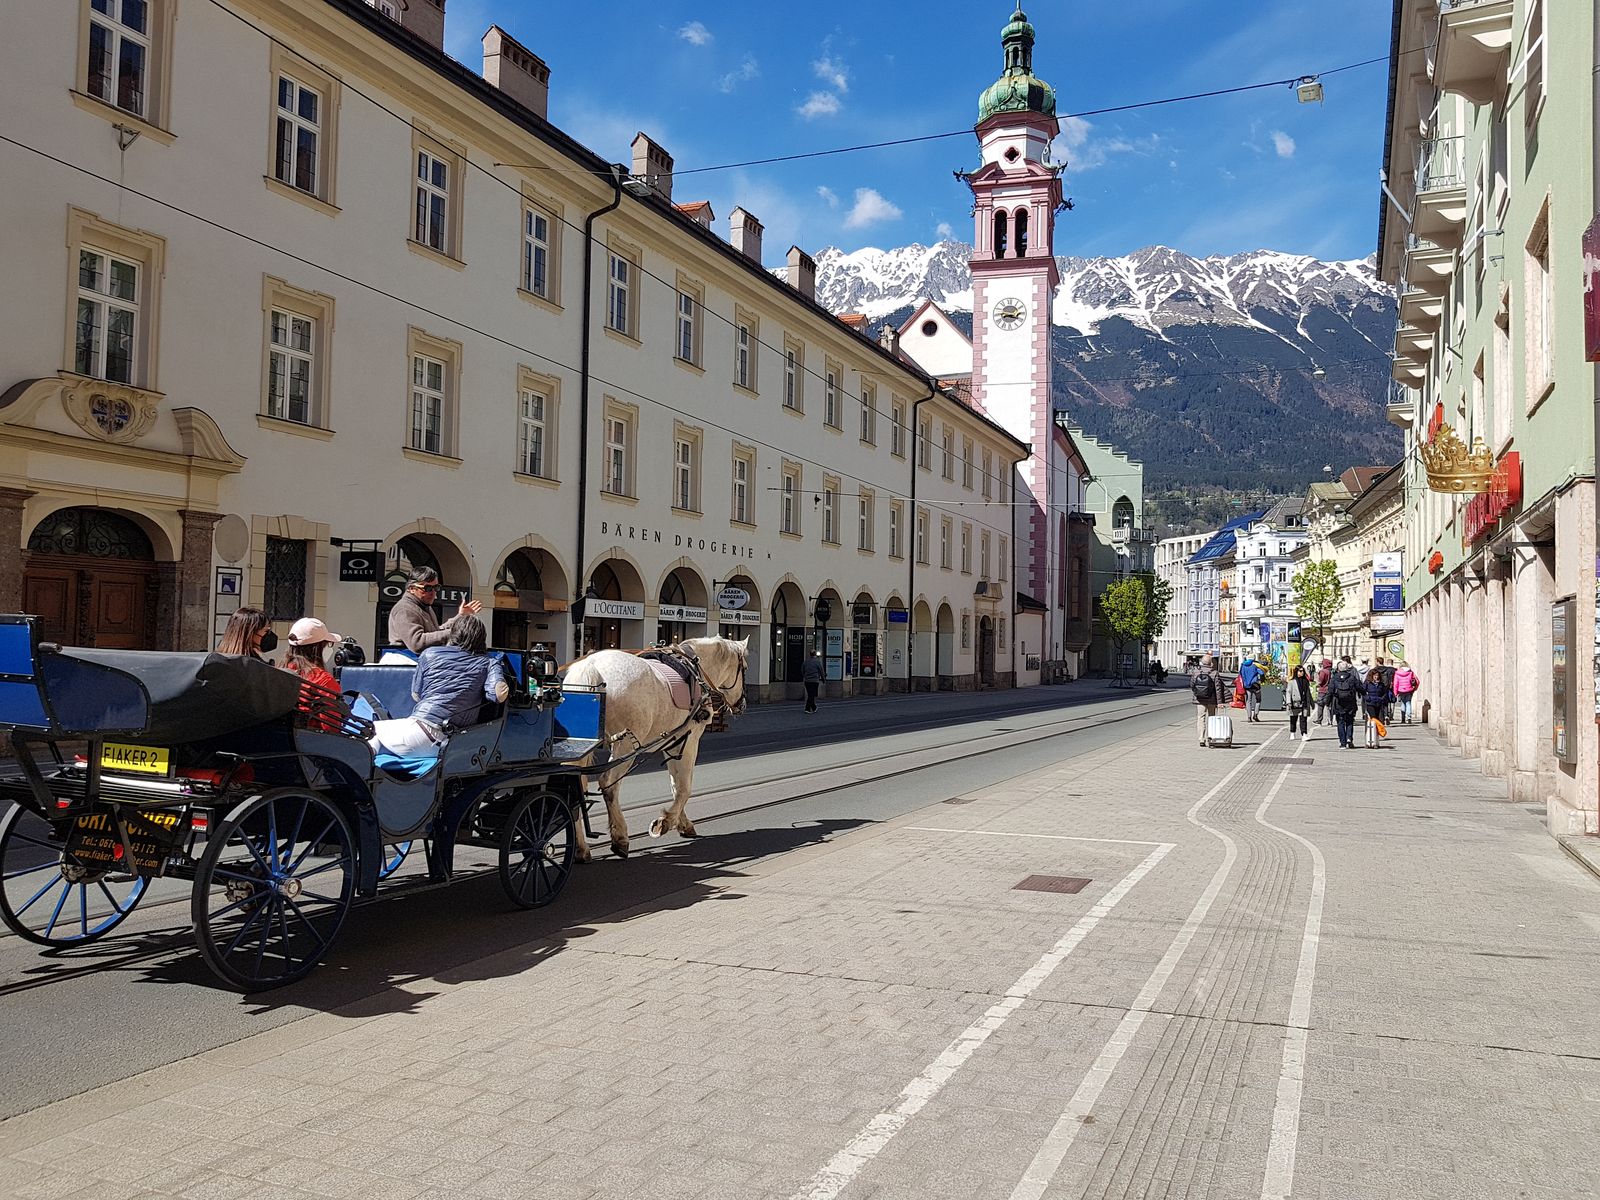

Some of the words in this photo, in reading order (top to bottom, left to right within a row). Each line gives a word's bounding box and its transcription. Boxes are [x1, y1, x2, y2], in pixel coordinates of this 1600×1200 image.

[602, 521, 661, 543] BÄREN
[675, 534, 753, 558] DROGERIE
[660, 607, 675, 616] BÄREN
[685, 610, 706, 618] DROGERIE
[104, 747, 147, 767] FIAKER
[150, 752, 158, 768] 2
